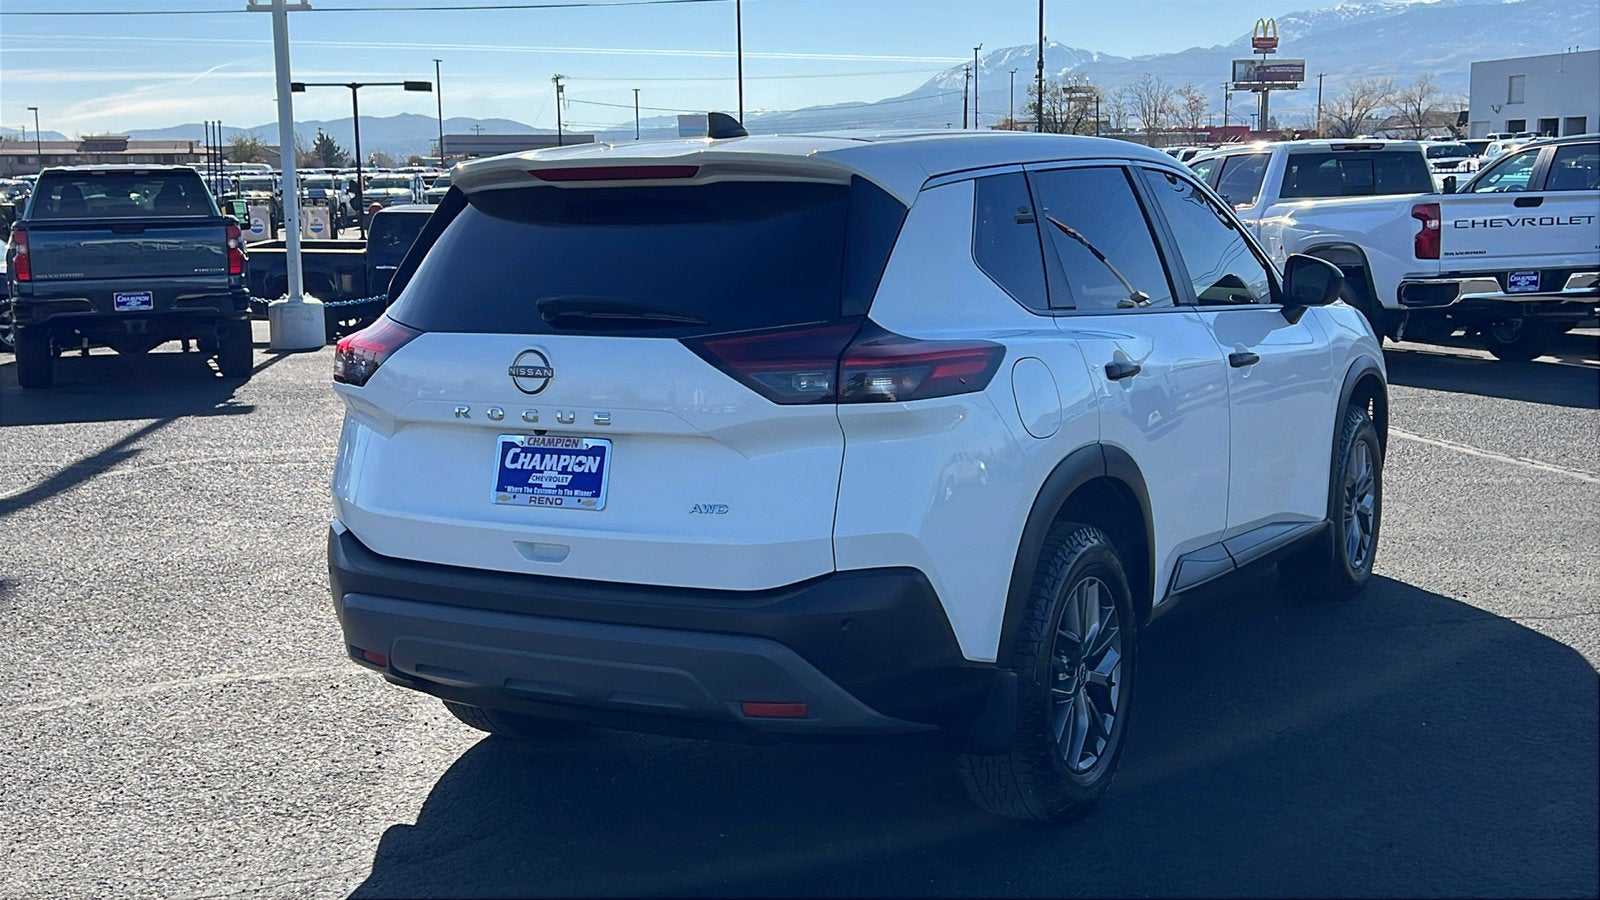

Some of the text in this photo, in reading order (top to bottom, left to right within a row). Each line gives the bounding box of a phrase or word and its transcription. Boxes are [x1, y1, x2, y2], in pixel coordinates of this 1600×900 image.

[1454, 215, 1596, 229] CHEVROLET
[509, 367, 553, 377] NISSAN
[454, 404, 612, 426] ROGUE
[527, 437, 580, 448] CHAMPION
[504, 447, 601, 473] CHAMPION
[531, 474, 569, 483] CHEVROLET
[523, 486, 533, 494] The
[534, 487, 557, 495] Customer
[564, 488, 573, 496] The
[528, 496, 563, 506] RENO
[688, 503, 729, 515] AWD
